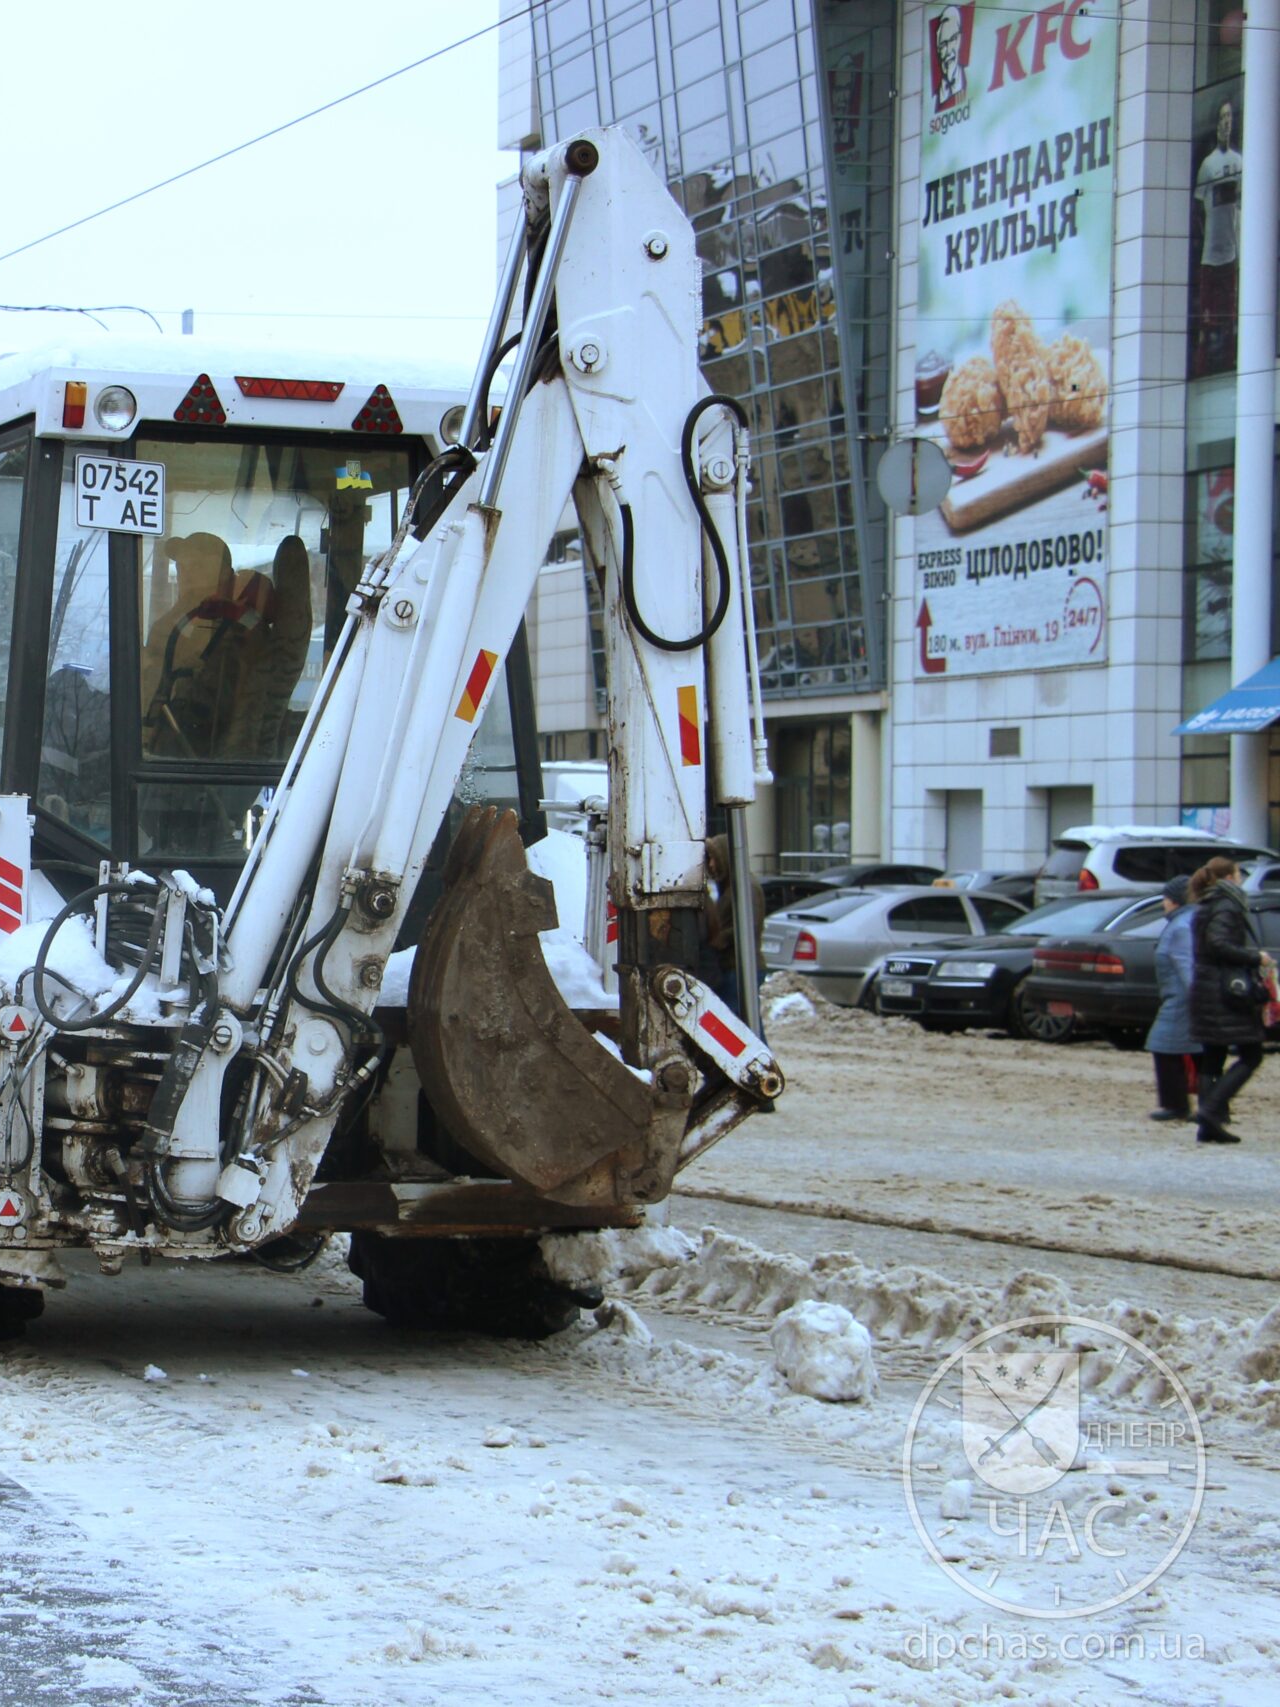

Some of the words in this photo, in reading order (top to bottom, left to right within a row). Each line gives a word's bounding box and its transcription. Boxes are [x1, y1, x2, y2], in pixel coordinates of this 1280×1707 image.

[987, 0, 1096, 92] KFC
[923, 116, 1111, 228] ЛЕГЕНДАРНІ
[945, 193, 1079, 276] КРИЛЬЦЯ
[83, 463, 158, 496] 07542
[918, 548, 962, 570] EXPRESS
[966, 529, 1102, 585] ЦІЛОДОБОВО!
[924, 569, 956, 589] ВІКНО
[1045, 620, 1059, 642] 19
[1068, 606, 1098, 627] 24/7
